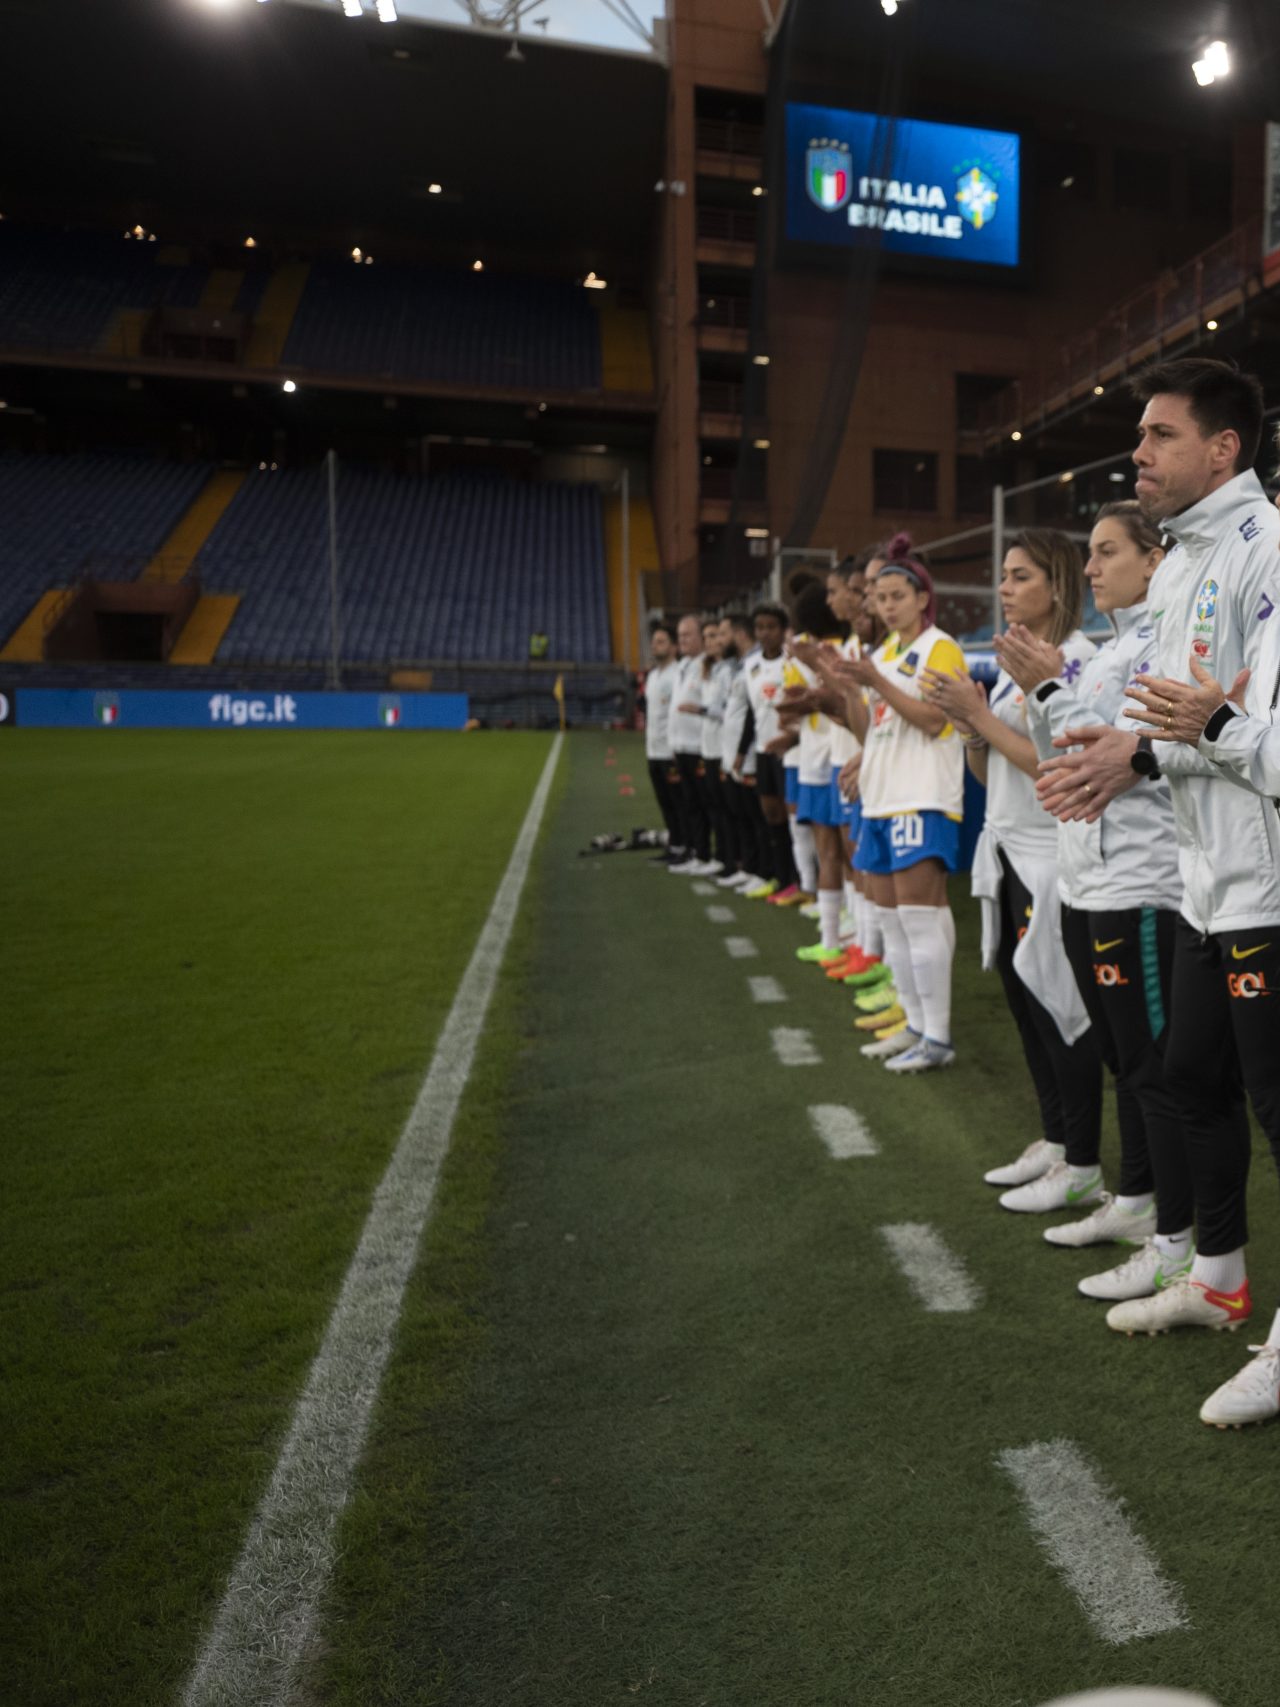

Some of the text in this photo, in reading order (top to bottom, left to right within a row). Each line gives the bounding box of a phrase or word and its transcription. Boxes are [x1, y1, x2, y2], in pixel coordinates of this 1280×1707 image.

[858, 177, 947, 209] ITALIA
[847, 203, 963, 239] BRASILE
[208, 694, 297, 725] figc.it
[890, 814, 923, 847] 20
